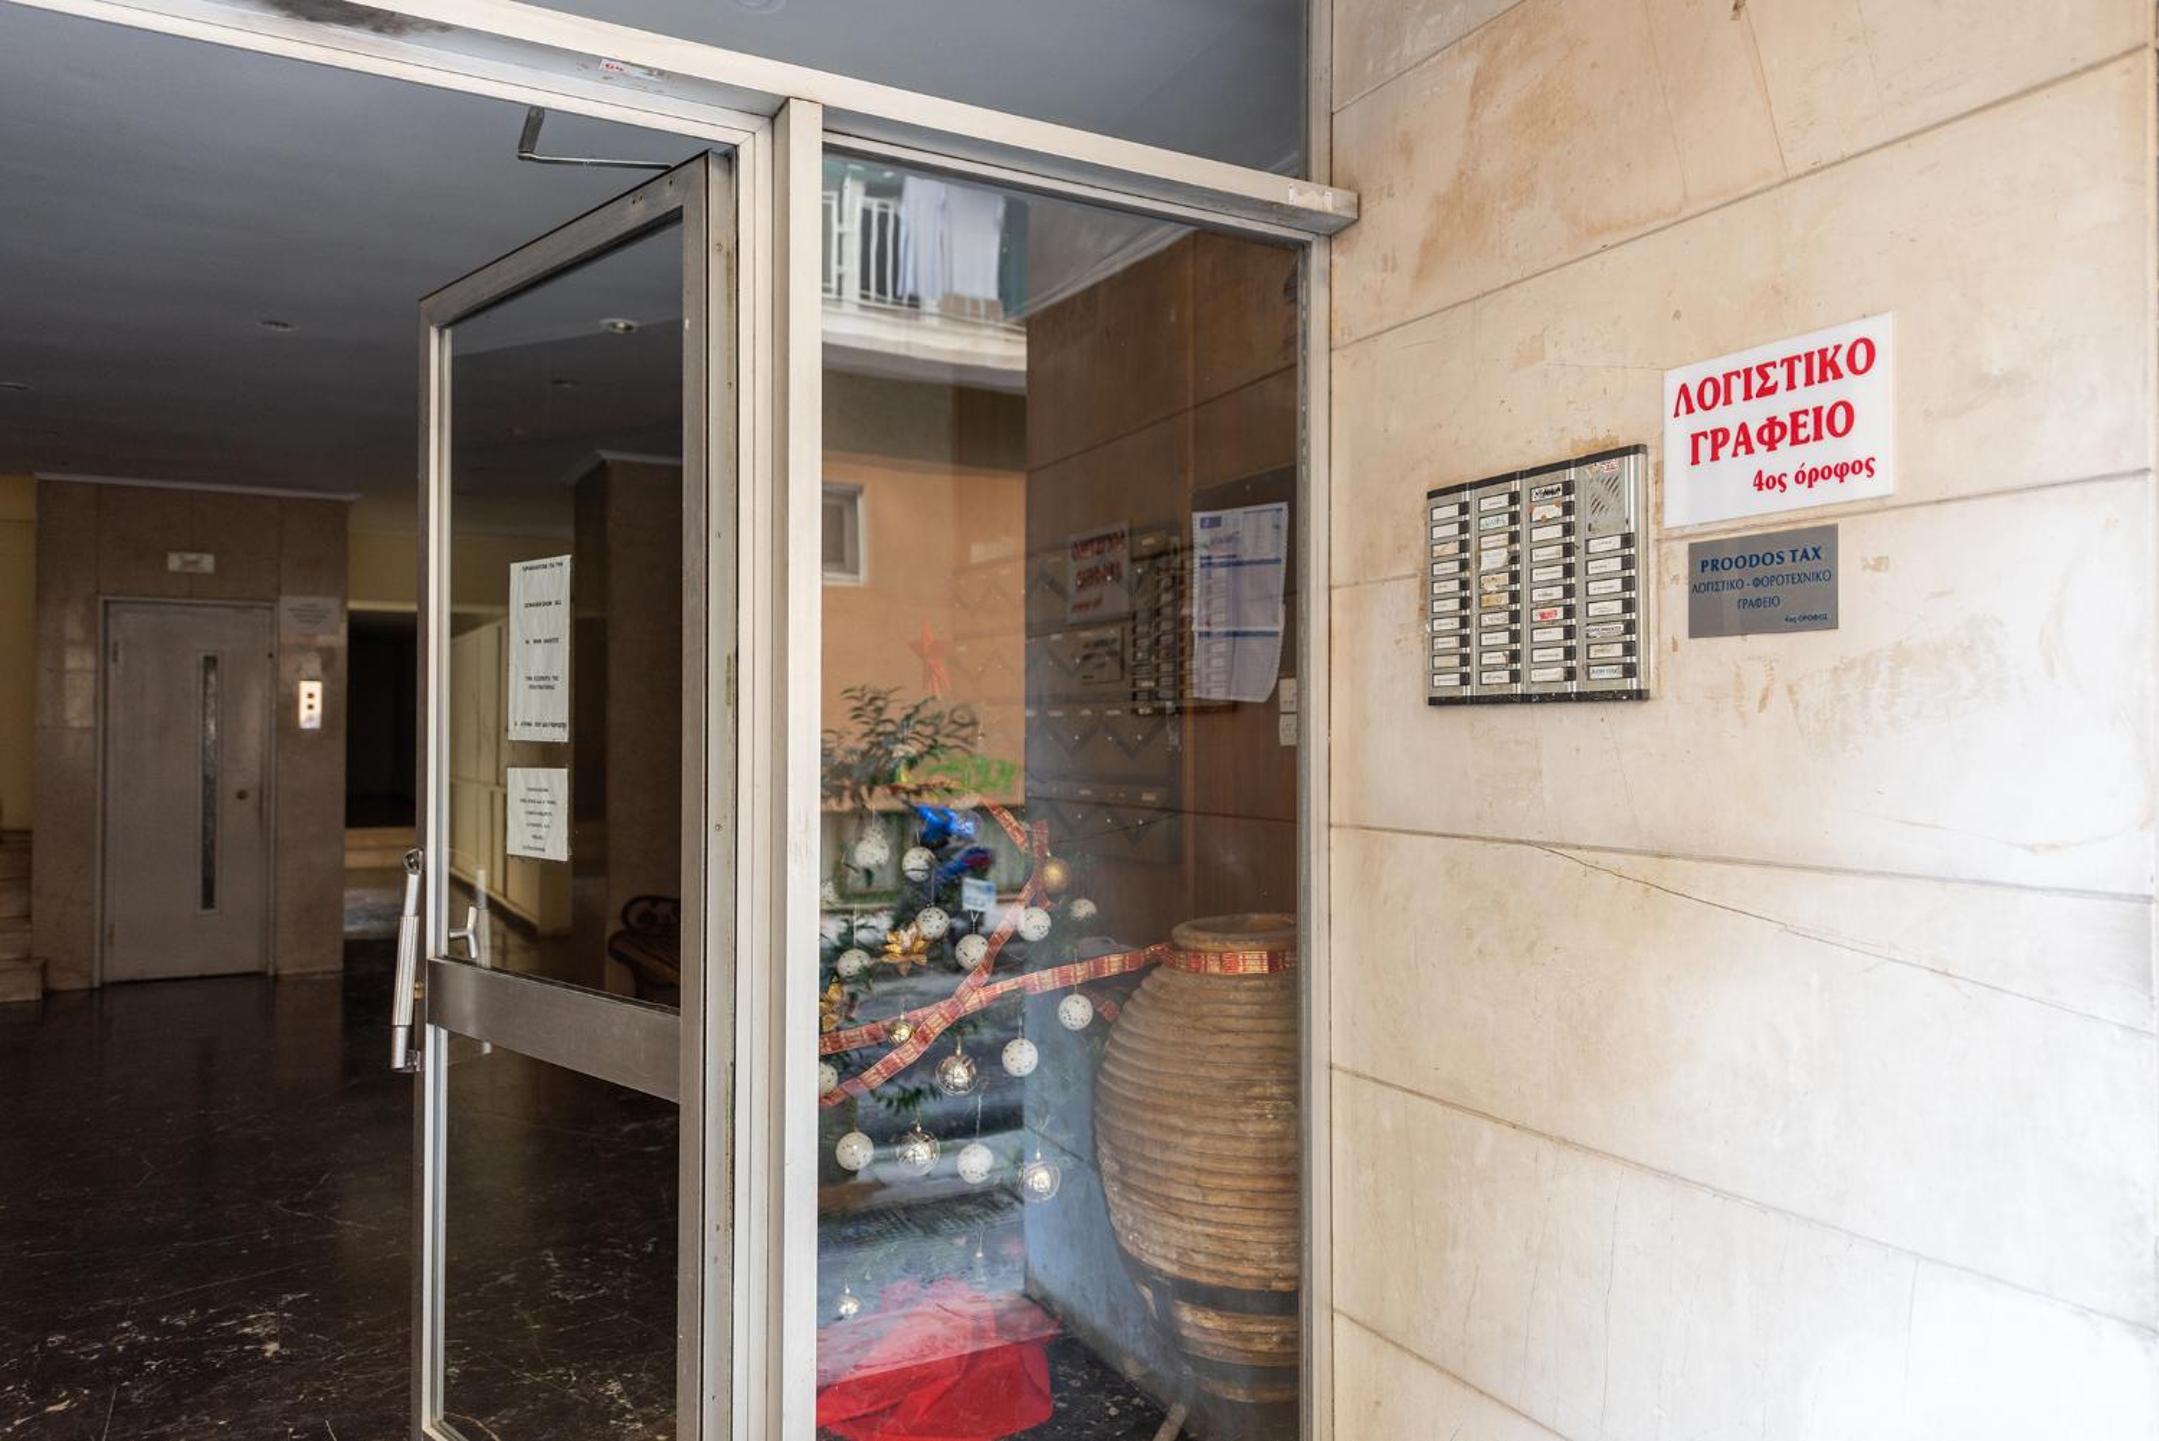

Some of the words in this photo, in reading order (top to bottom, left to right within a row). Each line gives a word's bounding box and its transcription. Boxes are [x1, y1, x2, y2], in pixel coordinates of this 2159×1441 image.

[1673, 337, 1876, 418] ΛΟΓΙΣΤΙΚΟ
[1690, 400, 1855, 466] ΓΡΑΦΕΙΟ
[1752, 470, 1788, 493] 4ος
[1794, 456, 1876, 488] όροφος
[1700, 550, 1785, 573] PROODOS
[1790, 546, 1823, 563] TAX
[1692, 578, 1744, 594] ΛΟΓΙΣΤΙΚΟ
[1752, 569, 1832, 588] ΦΟΡΟΤΕΧΝΙΚΟ
[1737, 595, 1781, 610] ΓΡΑΦΕΙΟ
